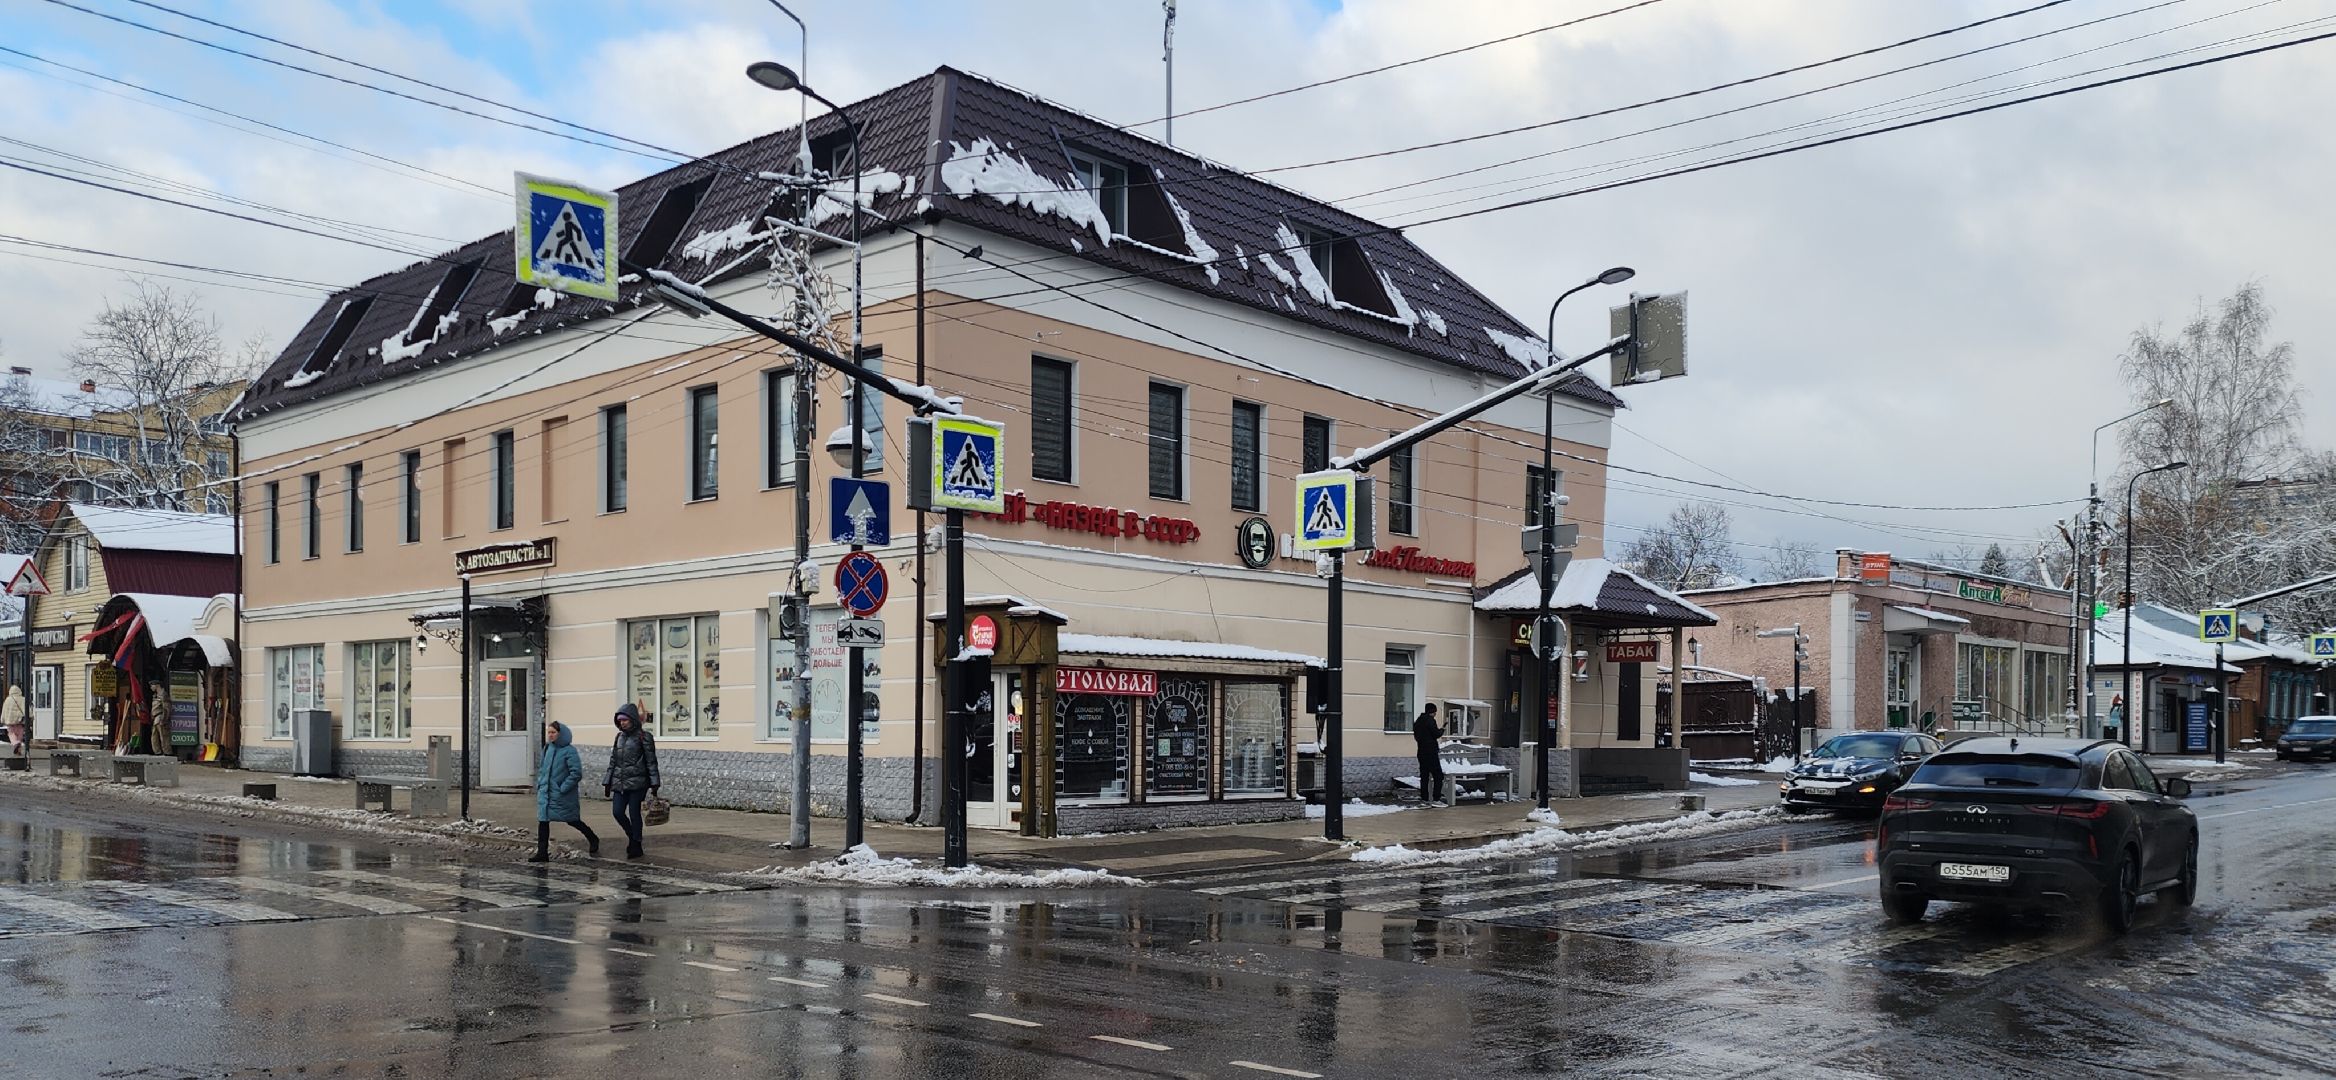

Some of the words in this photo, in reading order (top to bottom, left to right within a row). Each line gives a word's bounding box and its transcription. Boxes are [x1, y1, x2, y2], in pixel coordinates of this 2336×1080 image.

[1124, 512, 1139, 538] В
[466, 546, 535, 570] АВТОЗАПЧАСТИ
[815, 624, 837, 633] ТЕПЕР
[822, 636, 834, 644] МЫ
[811, 647, 846, 656] РАБОТАЕМ
[1609, 646, 1655, 658] ТАБАК
[813, 659, 843, 669] ДОЛЬШЕ
[1056, 669, 1153, 692] СТОЛОВАЯ
[171, 720, 197, 728] ТУРИЗМ
[171, 734, 196, 743] ОХОТА
